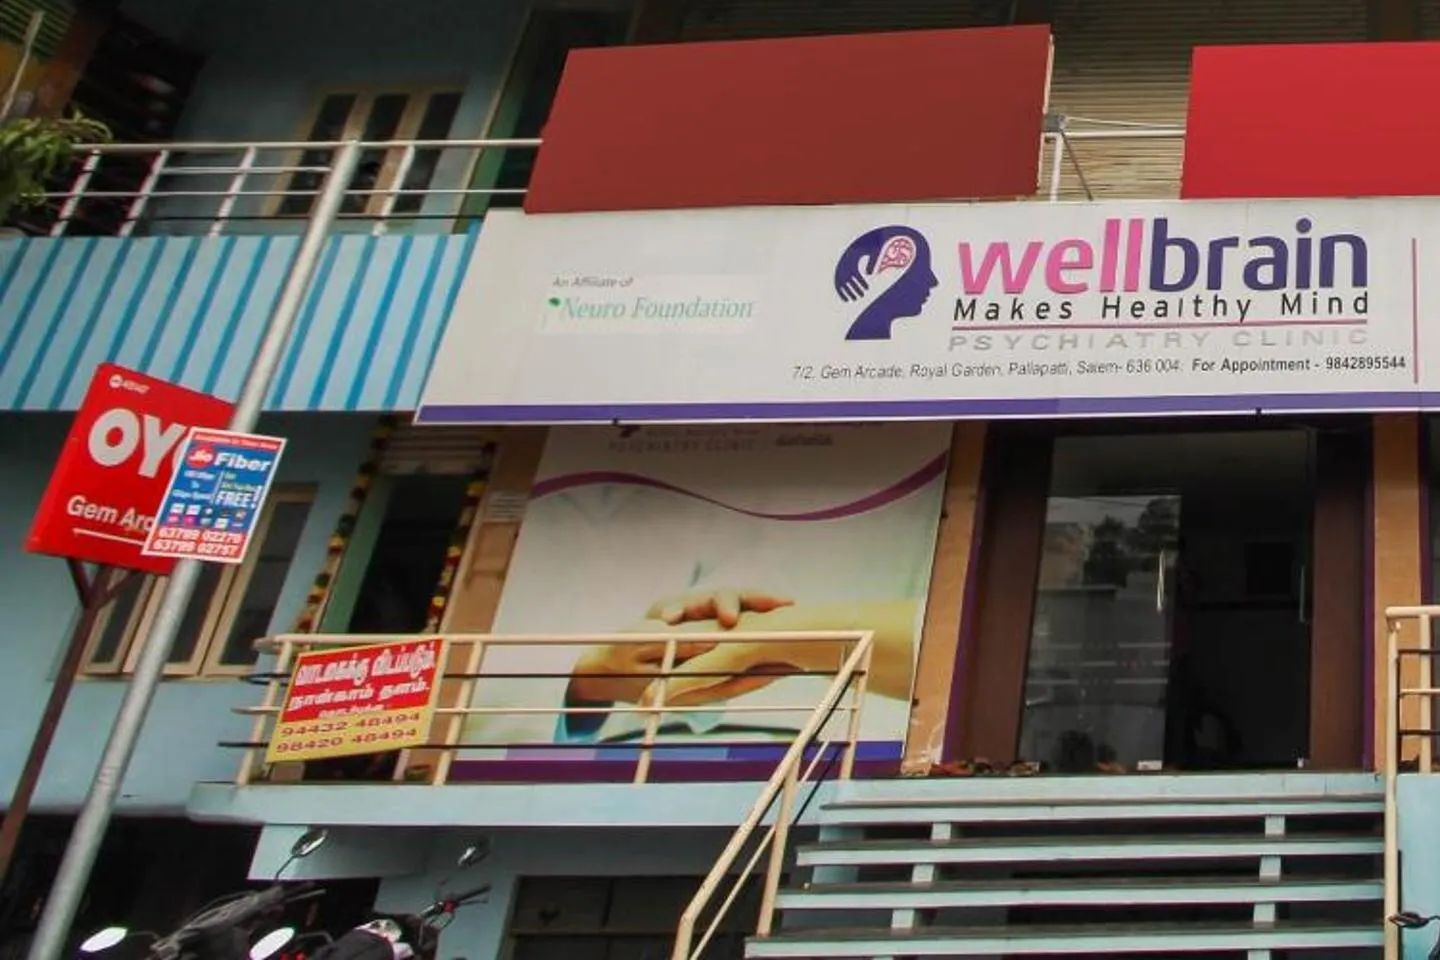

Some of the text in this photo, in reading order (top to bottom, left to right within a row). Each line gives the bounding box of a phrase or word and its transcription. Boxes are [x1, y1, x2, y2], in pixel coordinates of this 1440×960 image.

[957, 217, 1368, 295] wellbrain
[562, 296, 755, 319] Neuro Foundation
[953, 291, 1368, 324] Makes Healthy Mind
[949, 329, 1368, 352] PSYCHIATRY CLINIC
[820, 364, 851, 380] Gem
[909, 363, 947, 381] Royal
[1191, 358, 1216, 372] For
[1220, 357, 1310, 374] Appointment
[1325, 355, 1406, 371] 9842895544
[88, 407, 190, 478] OY
[214, 451, 271, 473] Fiber
[66, 494, 156, 533] Gem Arc
